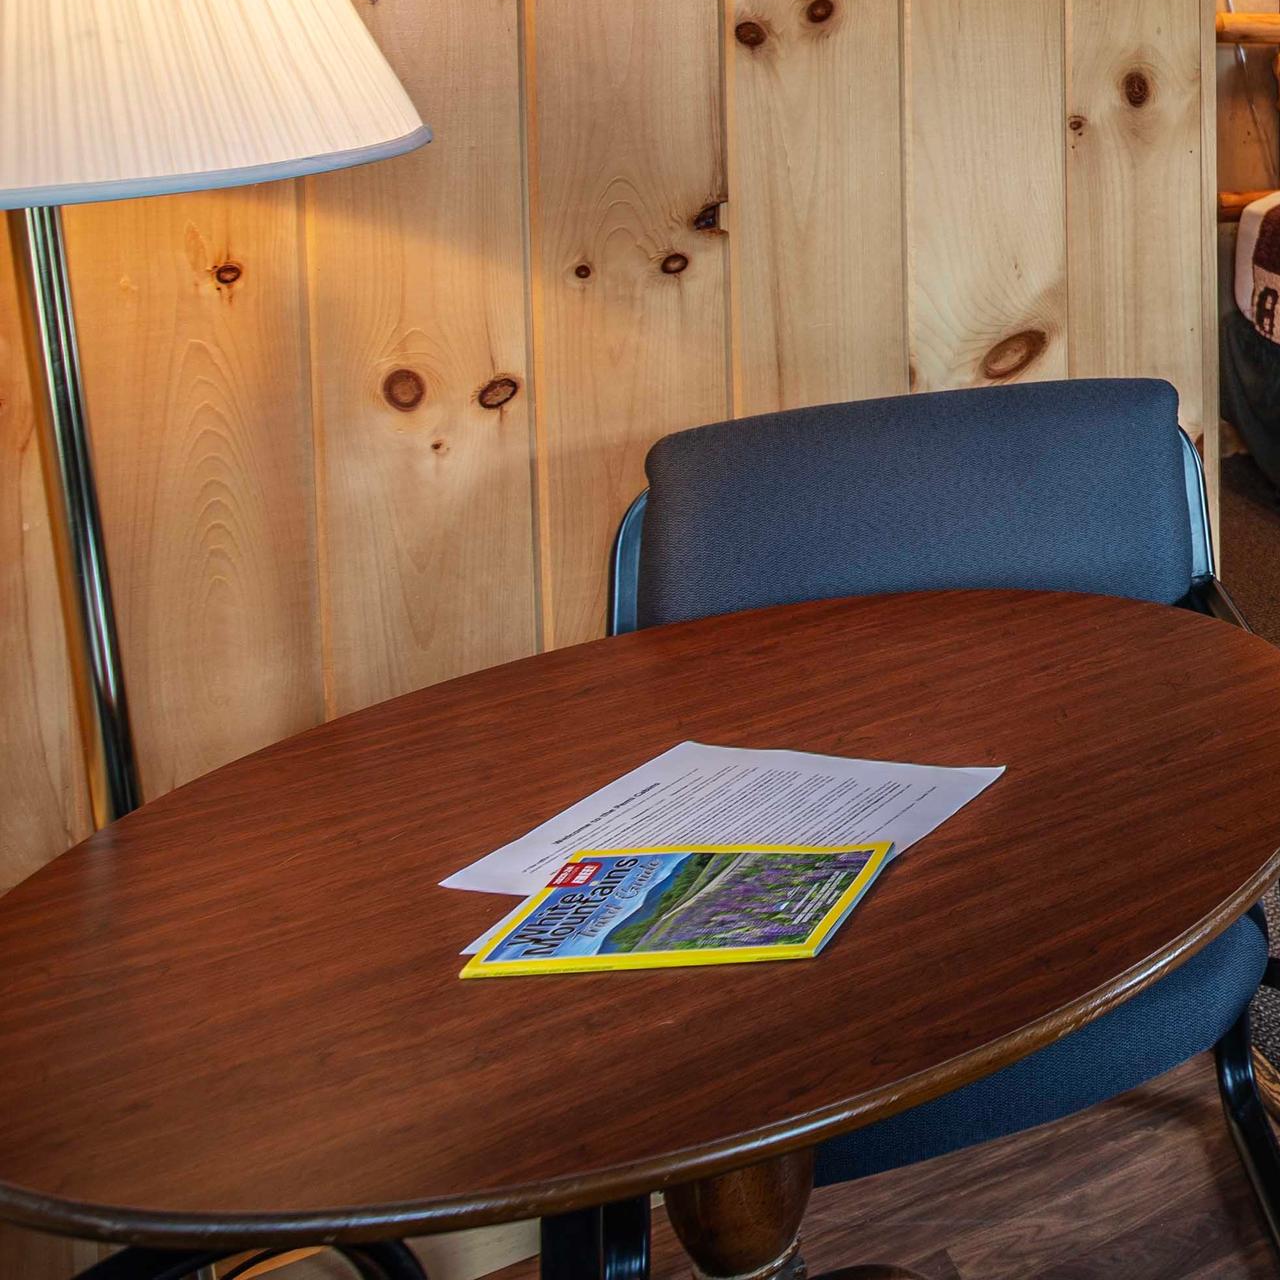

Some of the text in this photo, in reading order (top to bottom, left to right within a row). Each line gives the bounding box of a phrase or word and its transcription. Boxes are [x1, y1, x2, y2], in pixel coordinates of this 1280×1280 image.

[507, 892, 584, 947] White
[521, 857, 639, 957] Mountains
[572, 858, 662, 940] Travel Guide
